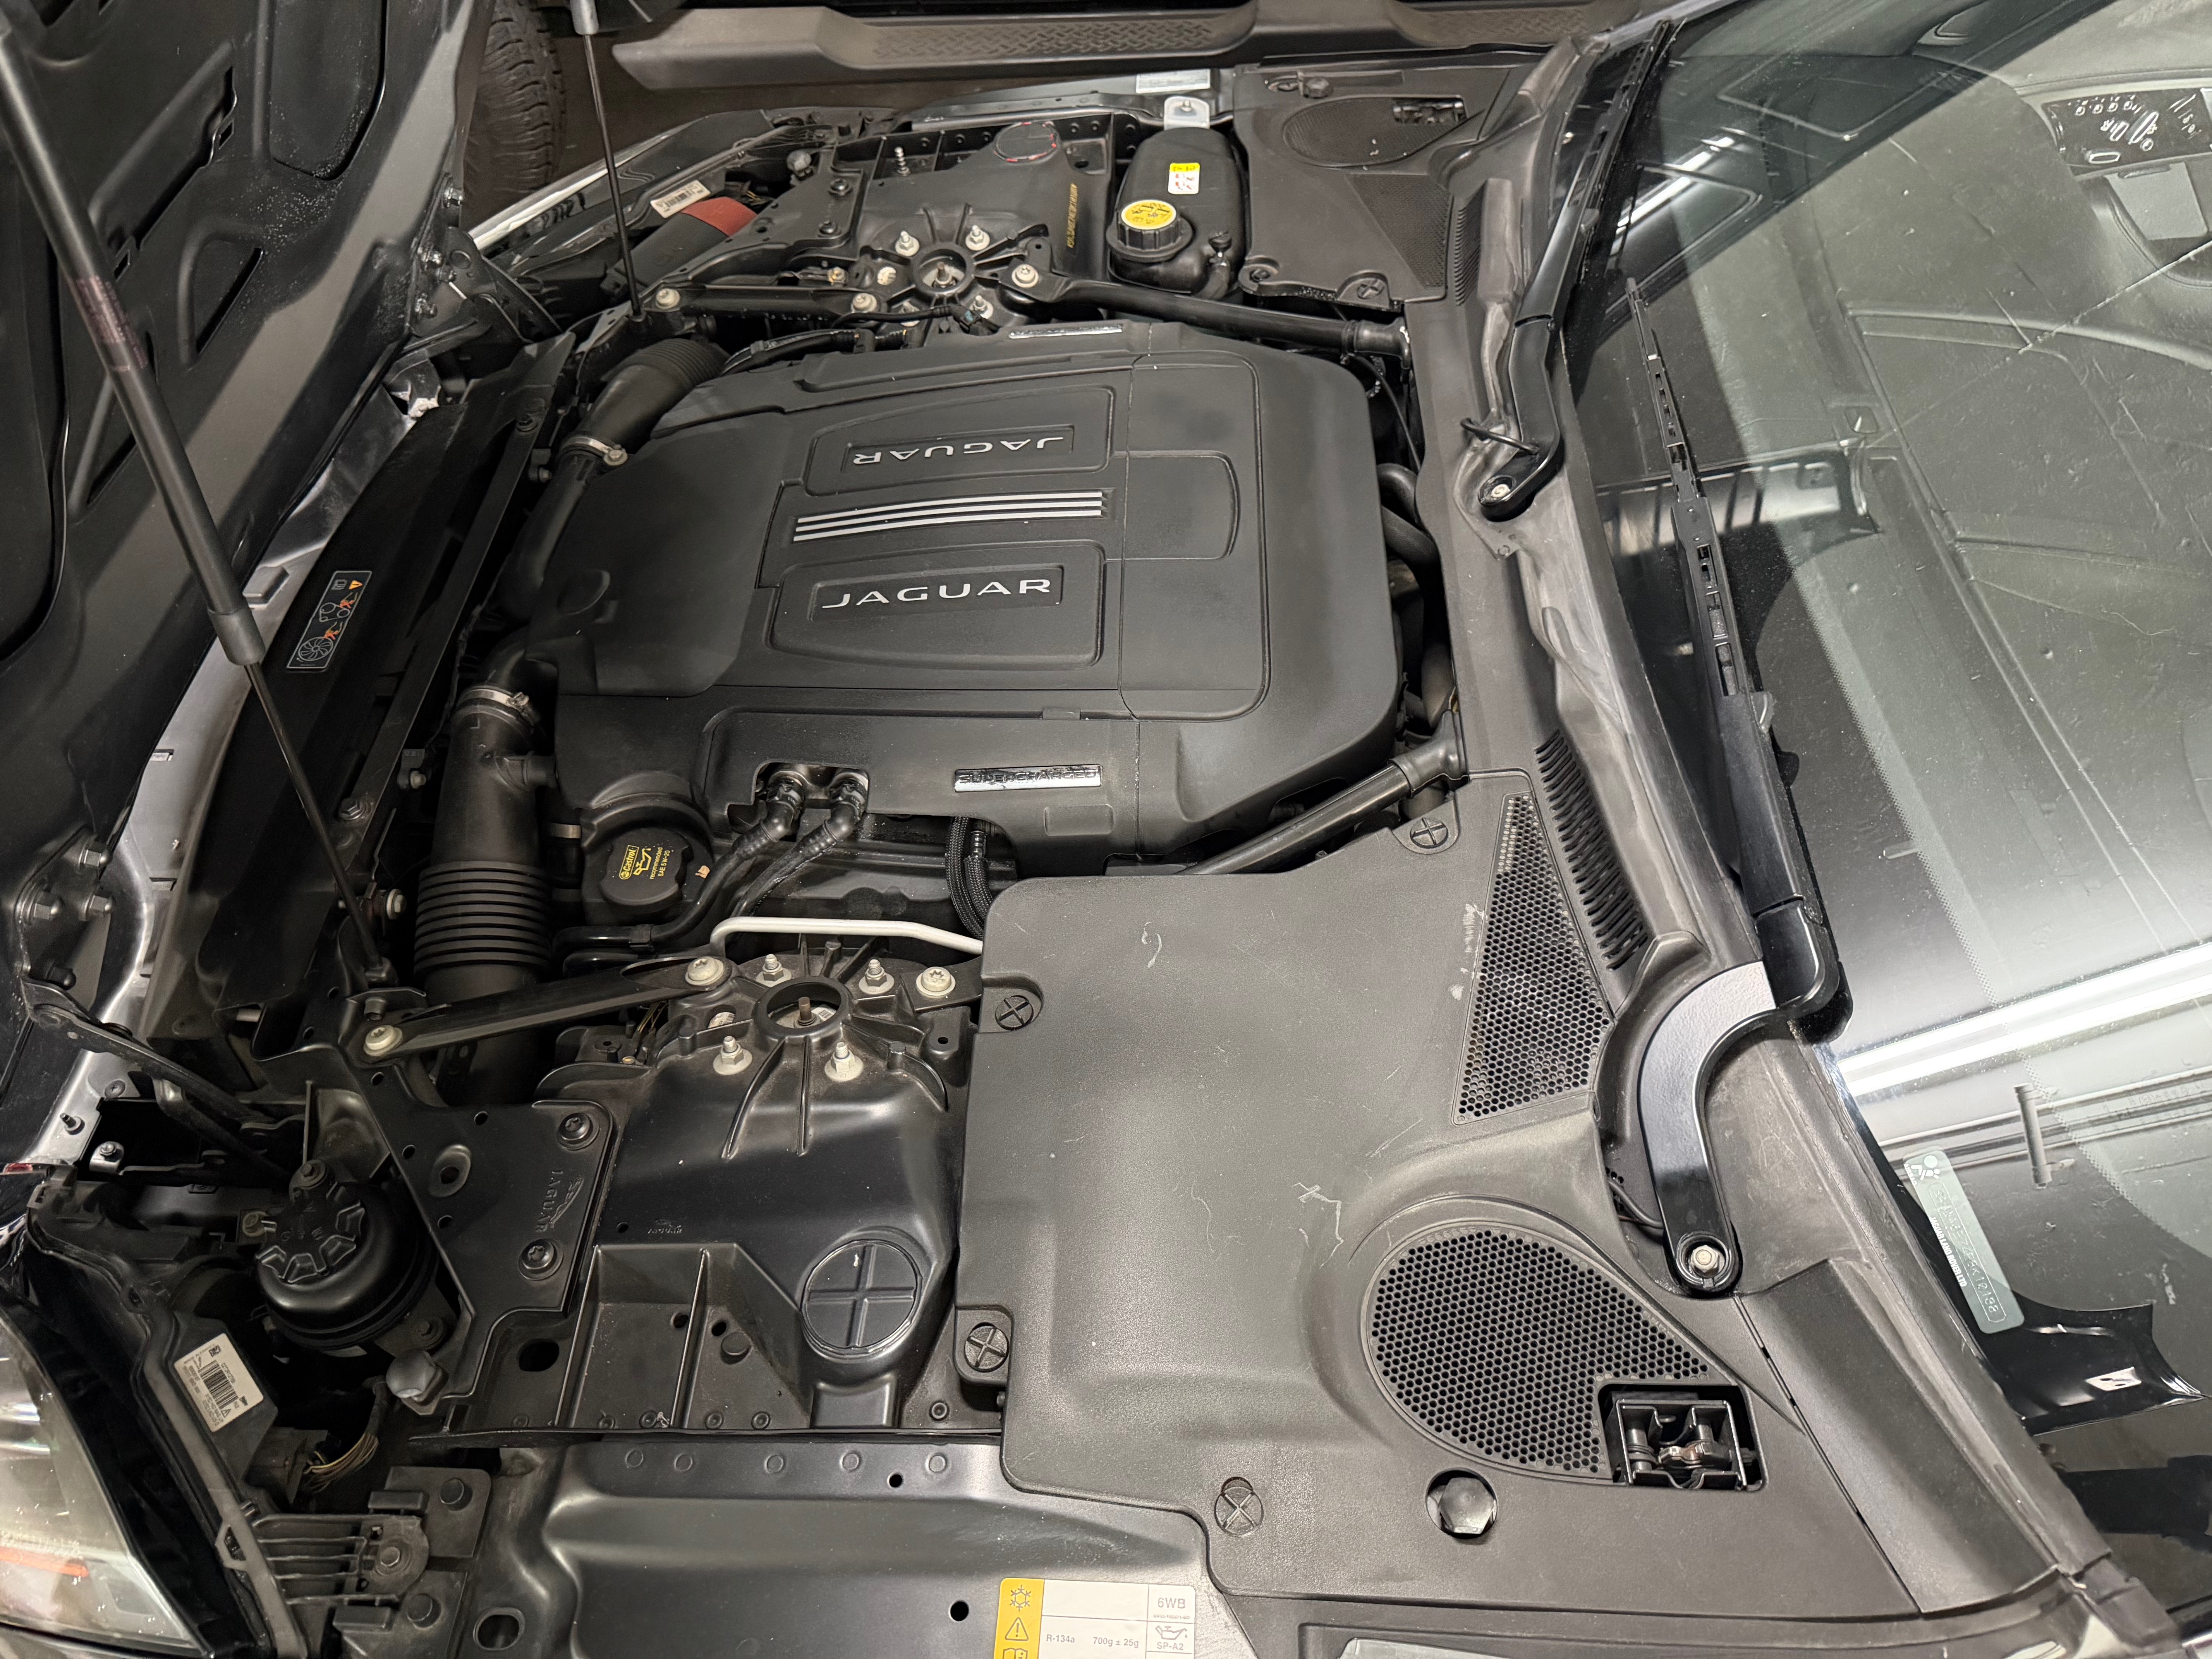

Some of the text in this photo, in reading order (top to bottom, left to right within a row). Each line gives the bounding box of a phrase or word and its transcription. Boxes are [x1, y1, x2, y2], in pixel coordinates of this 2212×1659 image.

[852, 436, 1065, 465] JAGUAR
[822, 578, 1050, 609] JAGUAR
[958, 770, 1097, 783] SUPERCHARGED
[623, 849, 635, 871] Castrol
[649, 847, 663, 879] recommended
[1903, 1163, 1917, 1186] AIRBAG
[535, 1170, 563, 1232] JAGUAR
[1929, 1216, 1967, 1287] JAGUAR LAND ROVER LTD
[1158, 1597, 1185, 1609] 6WB
[1046, 1634, 1075, 1643] R-134a
[1093, 1637, 1113, 1647] 700g
[1123, 1638, 1139, 1648] 25g
[1157, 1642, 1183, 1650] SP-A2
